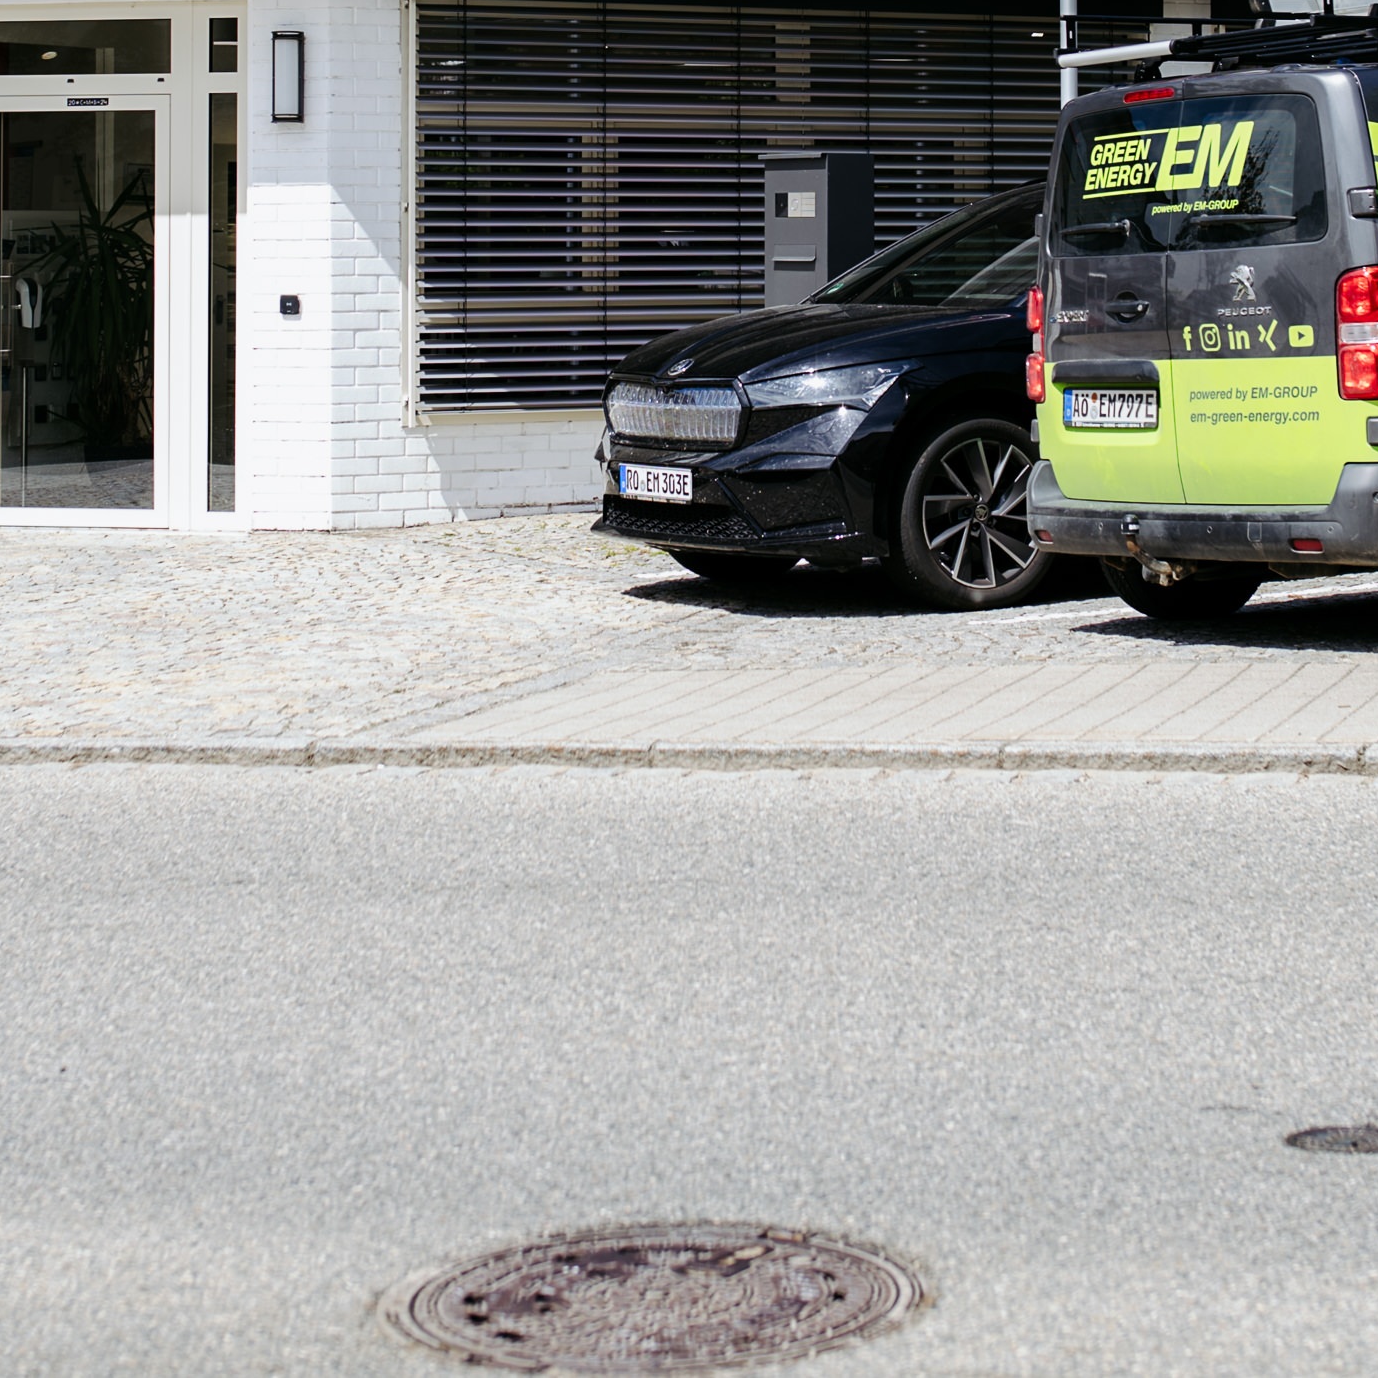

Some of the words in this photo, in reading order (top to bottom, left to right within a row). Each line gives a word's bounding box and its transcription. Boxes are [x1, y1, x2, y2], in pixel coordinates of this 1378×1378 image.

[1090, 138, 1152, 164] GREEN
[1155, 121, 1254, 192] EM
[1084, 161, 1157, 191] ENERGY
[1151, 203, 1183, 216] powered
[1183, 202, 1193, 213] by
[1193, 199, 1239, 211] EM-GROUP
[1217, 306, 1272, 316] PEUGEOT
[1189, 387, 1234, 402] powered
[1236, 386, 1249, 402] by
[1250, 385, 1318, 400] EM-GROUP
[1190, 410, 1320, 425] em-green-energy.com
[627, 469, 639, 491] RO
